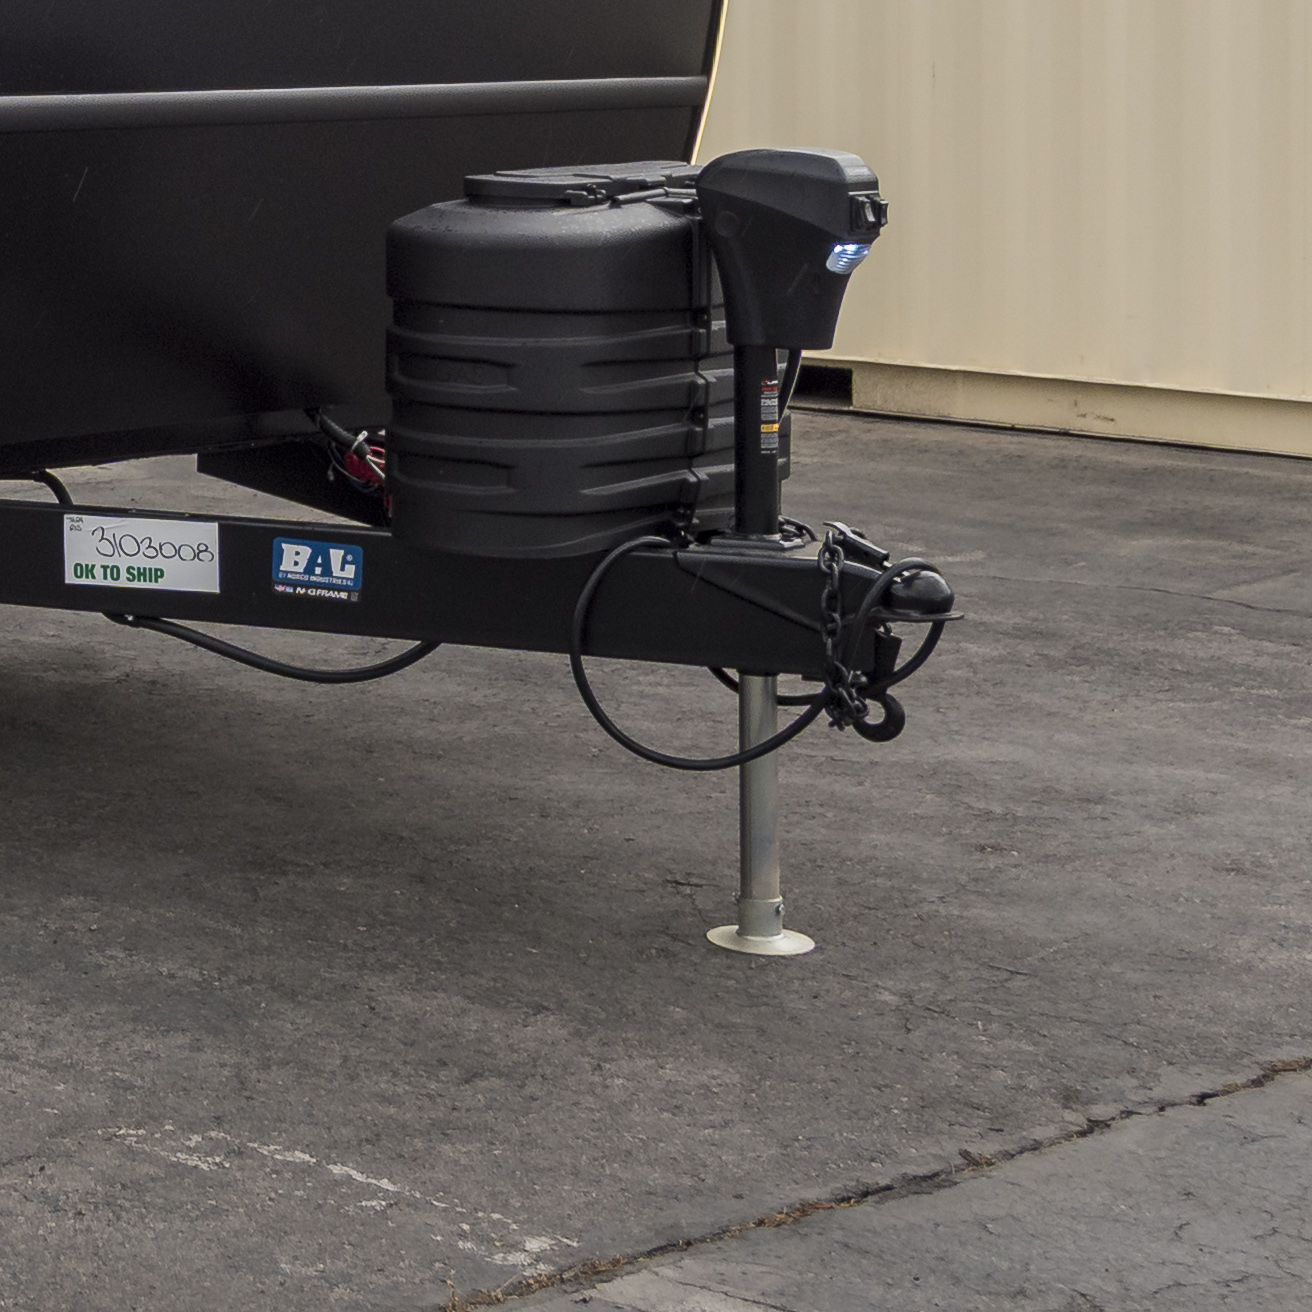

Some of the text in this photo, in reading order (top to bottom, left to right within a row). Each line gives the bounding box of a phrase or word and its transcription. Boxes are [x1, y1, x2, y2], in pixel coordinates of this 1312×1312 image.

[91, 526, 215, 563] 3103008
[73, 562, 165, 583] OK TO SHIP
